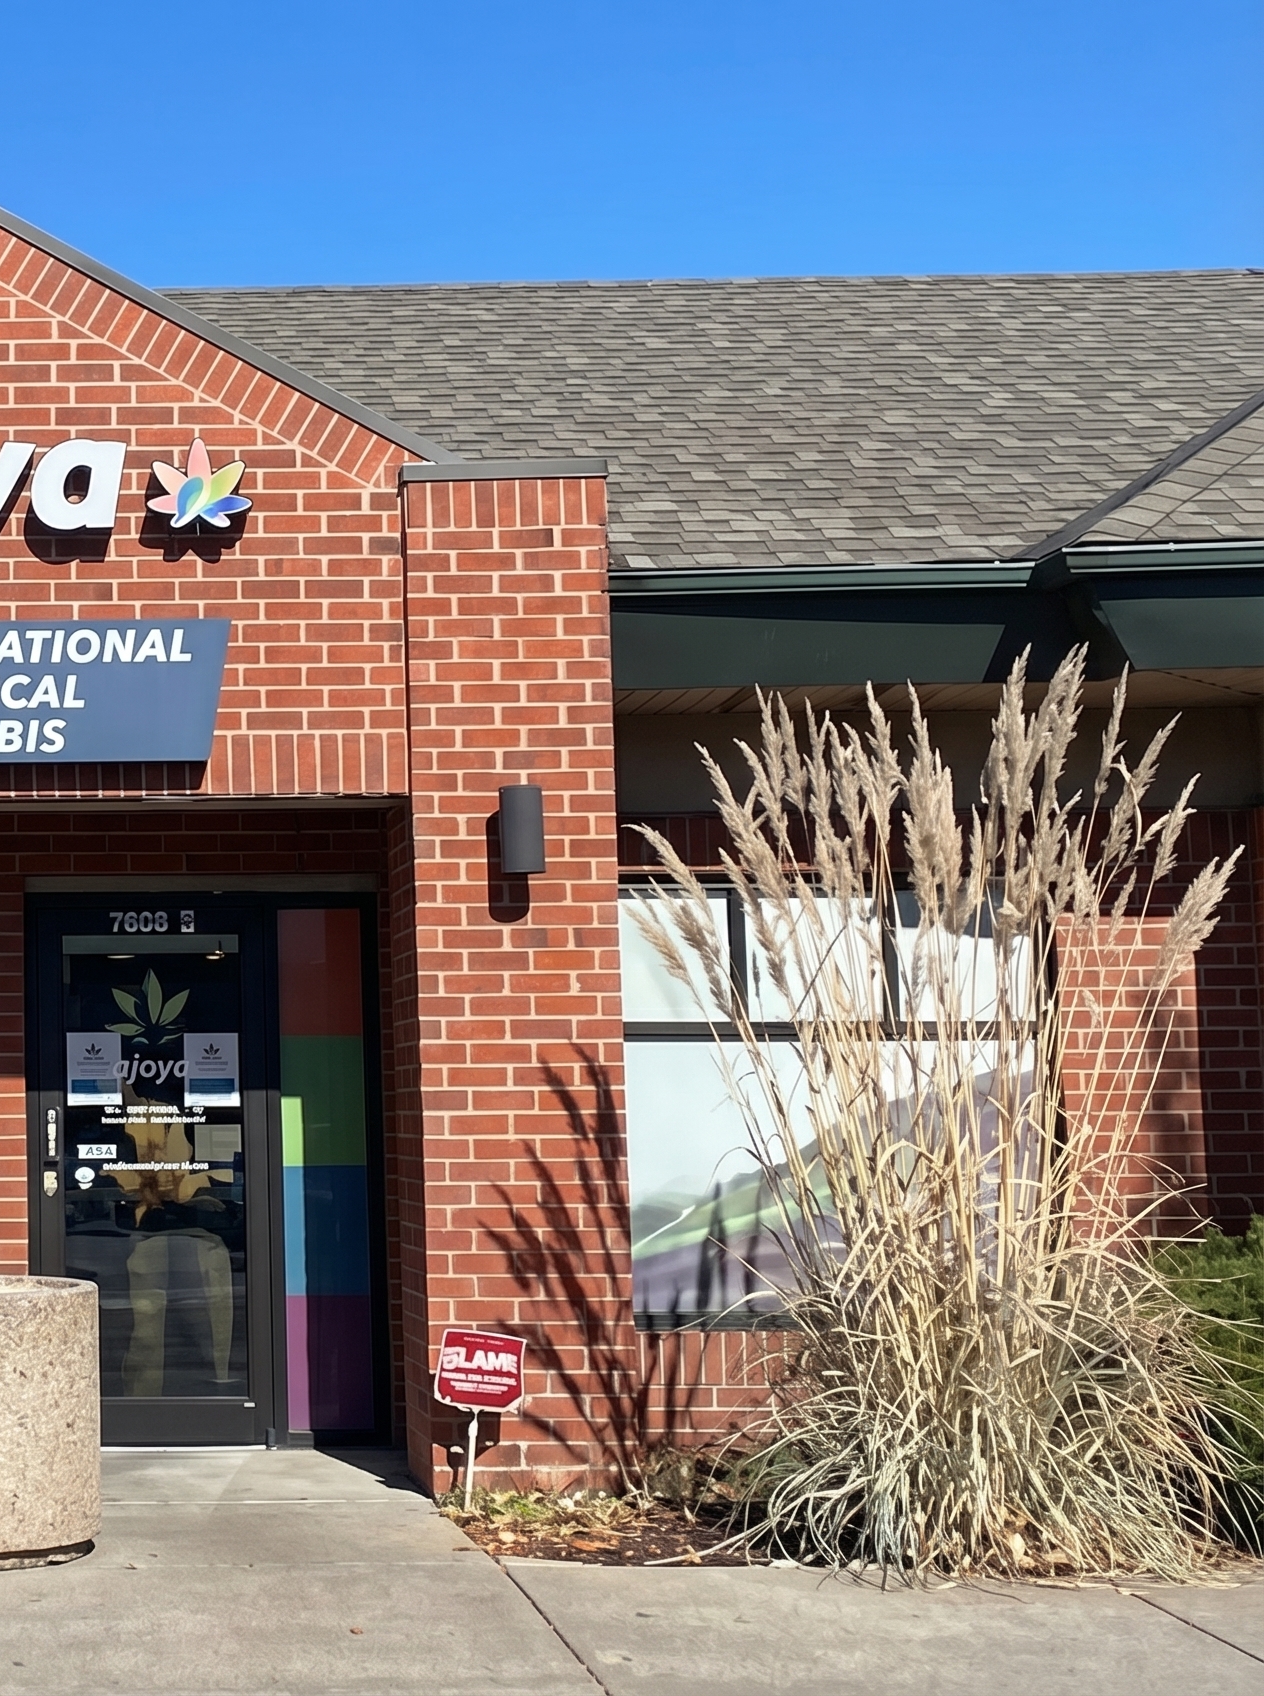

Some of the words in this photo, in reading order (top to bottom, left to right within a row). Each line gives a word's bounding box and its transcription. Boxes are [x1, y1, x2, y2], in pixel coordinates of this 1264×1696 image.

[109, 911, 168, 932] 7608
[113, 1053, 189, 1085] ajoya
[85, 1146, 113, 1156] ASA
